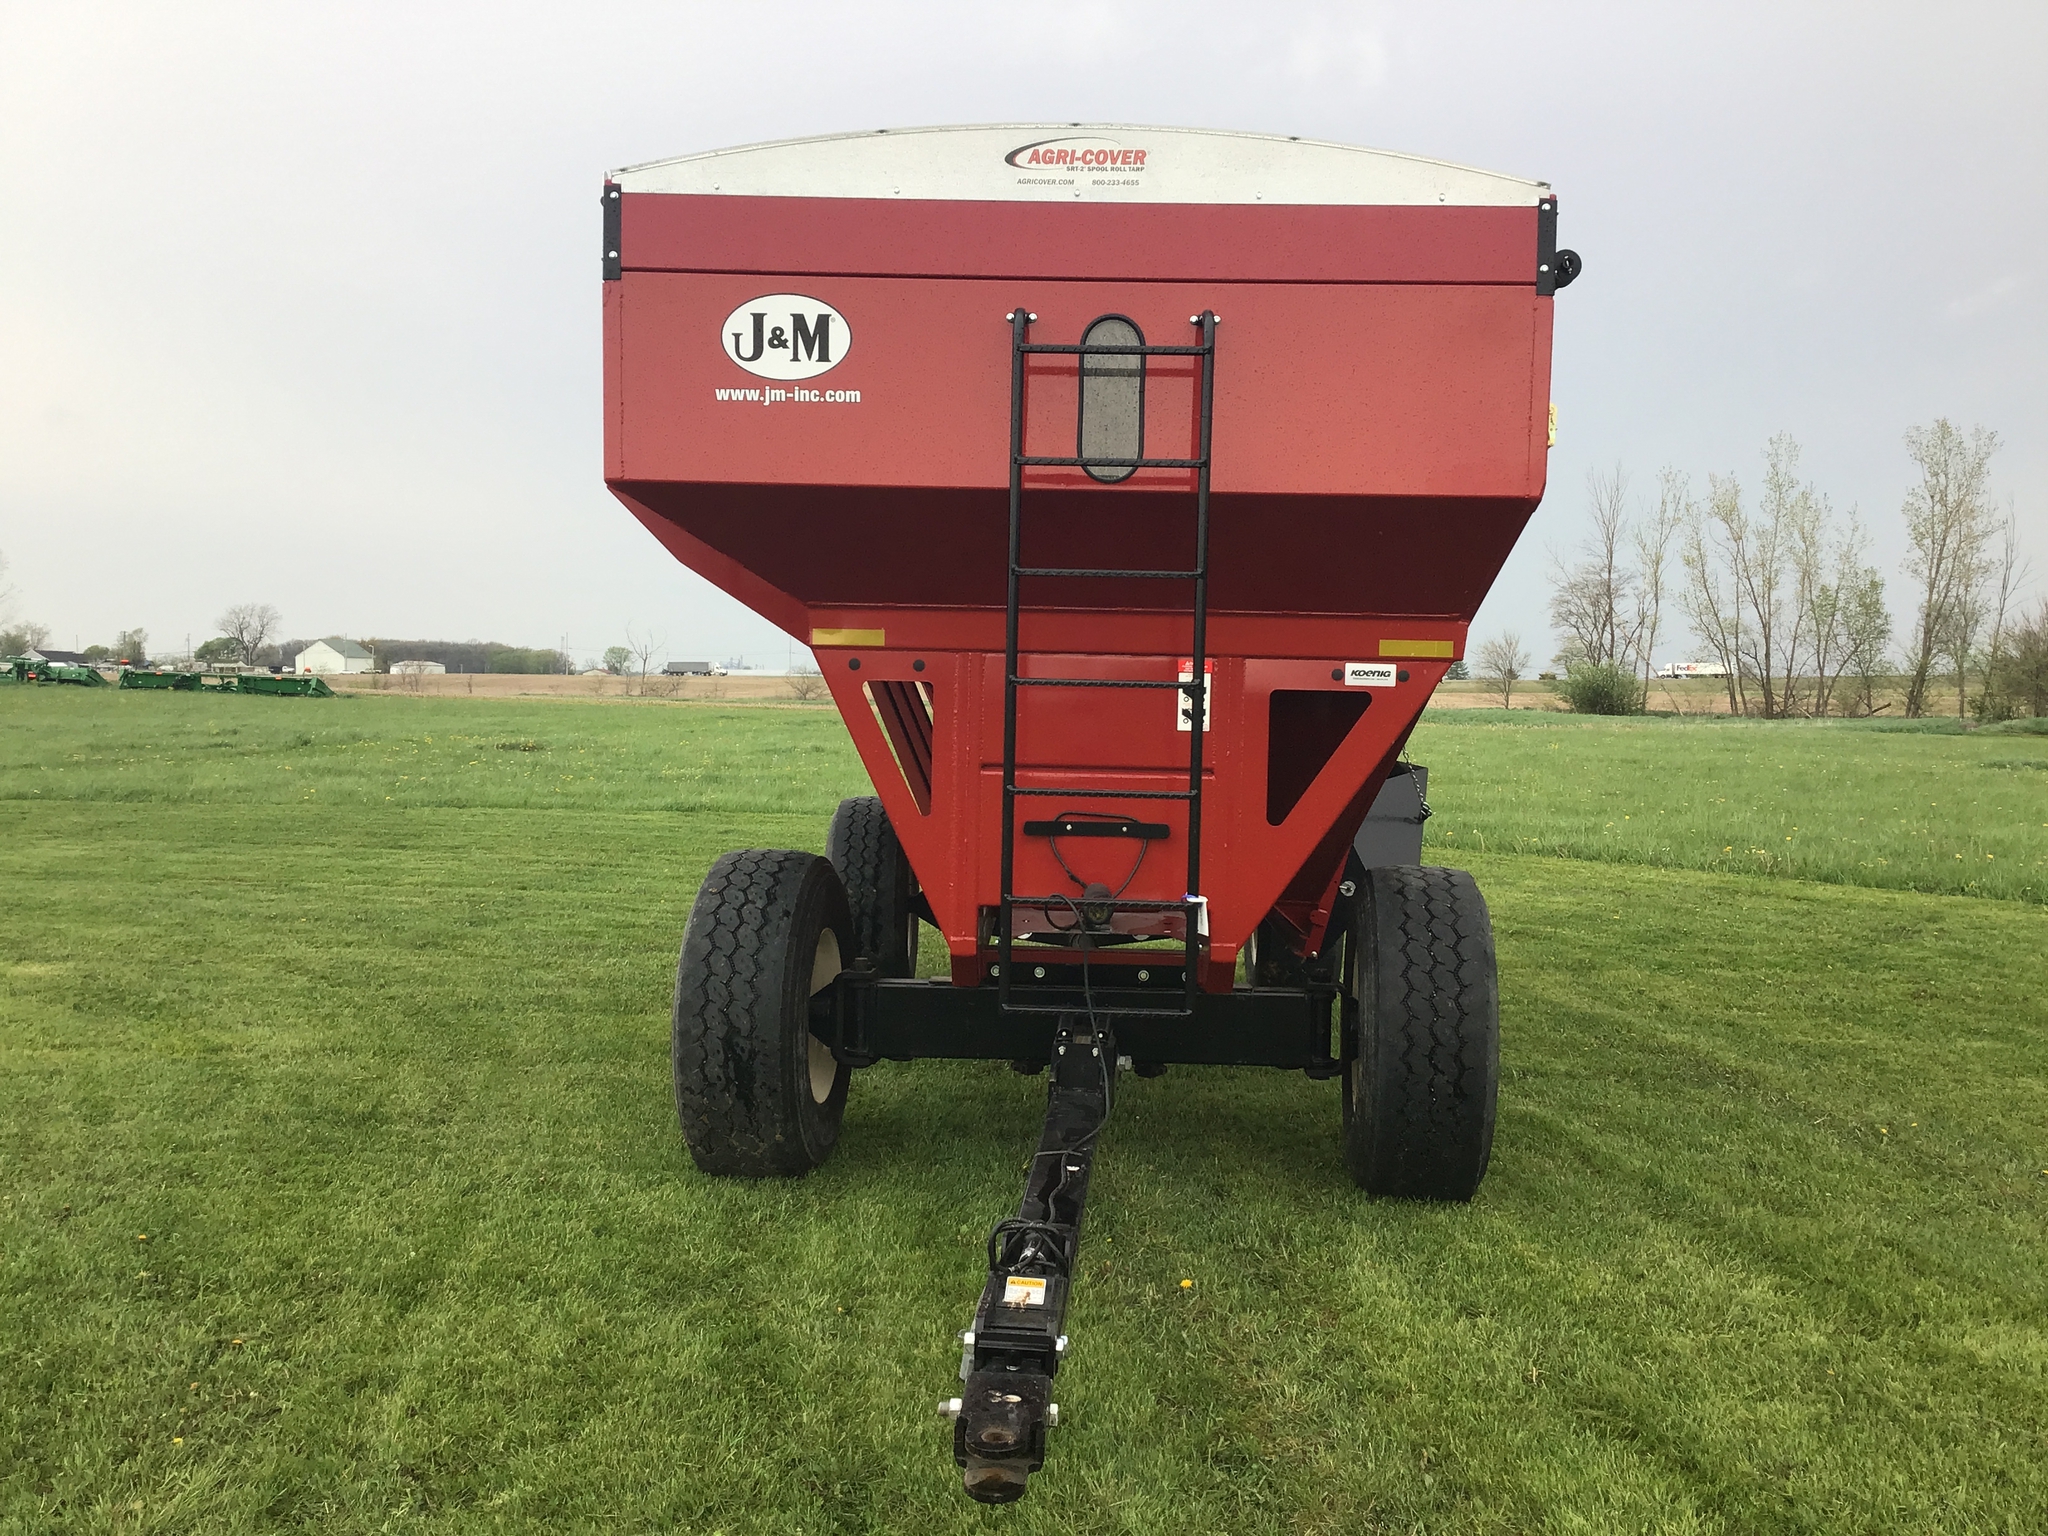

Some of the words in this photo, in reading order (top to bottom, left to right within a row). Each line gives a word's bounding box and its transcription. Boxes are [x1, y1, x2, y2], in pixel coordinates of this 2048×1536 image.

[1027, 149, 1147, 165] AGRI-COVER
[1016, 178, 1075, 186] AGRICOVER.COM
[1091, 179, 1140, 187] 800-233-4655
[731, 312, 832, 363] J&M
[715, 386, 861, 406] www.jm-inc.com
